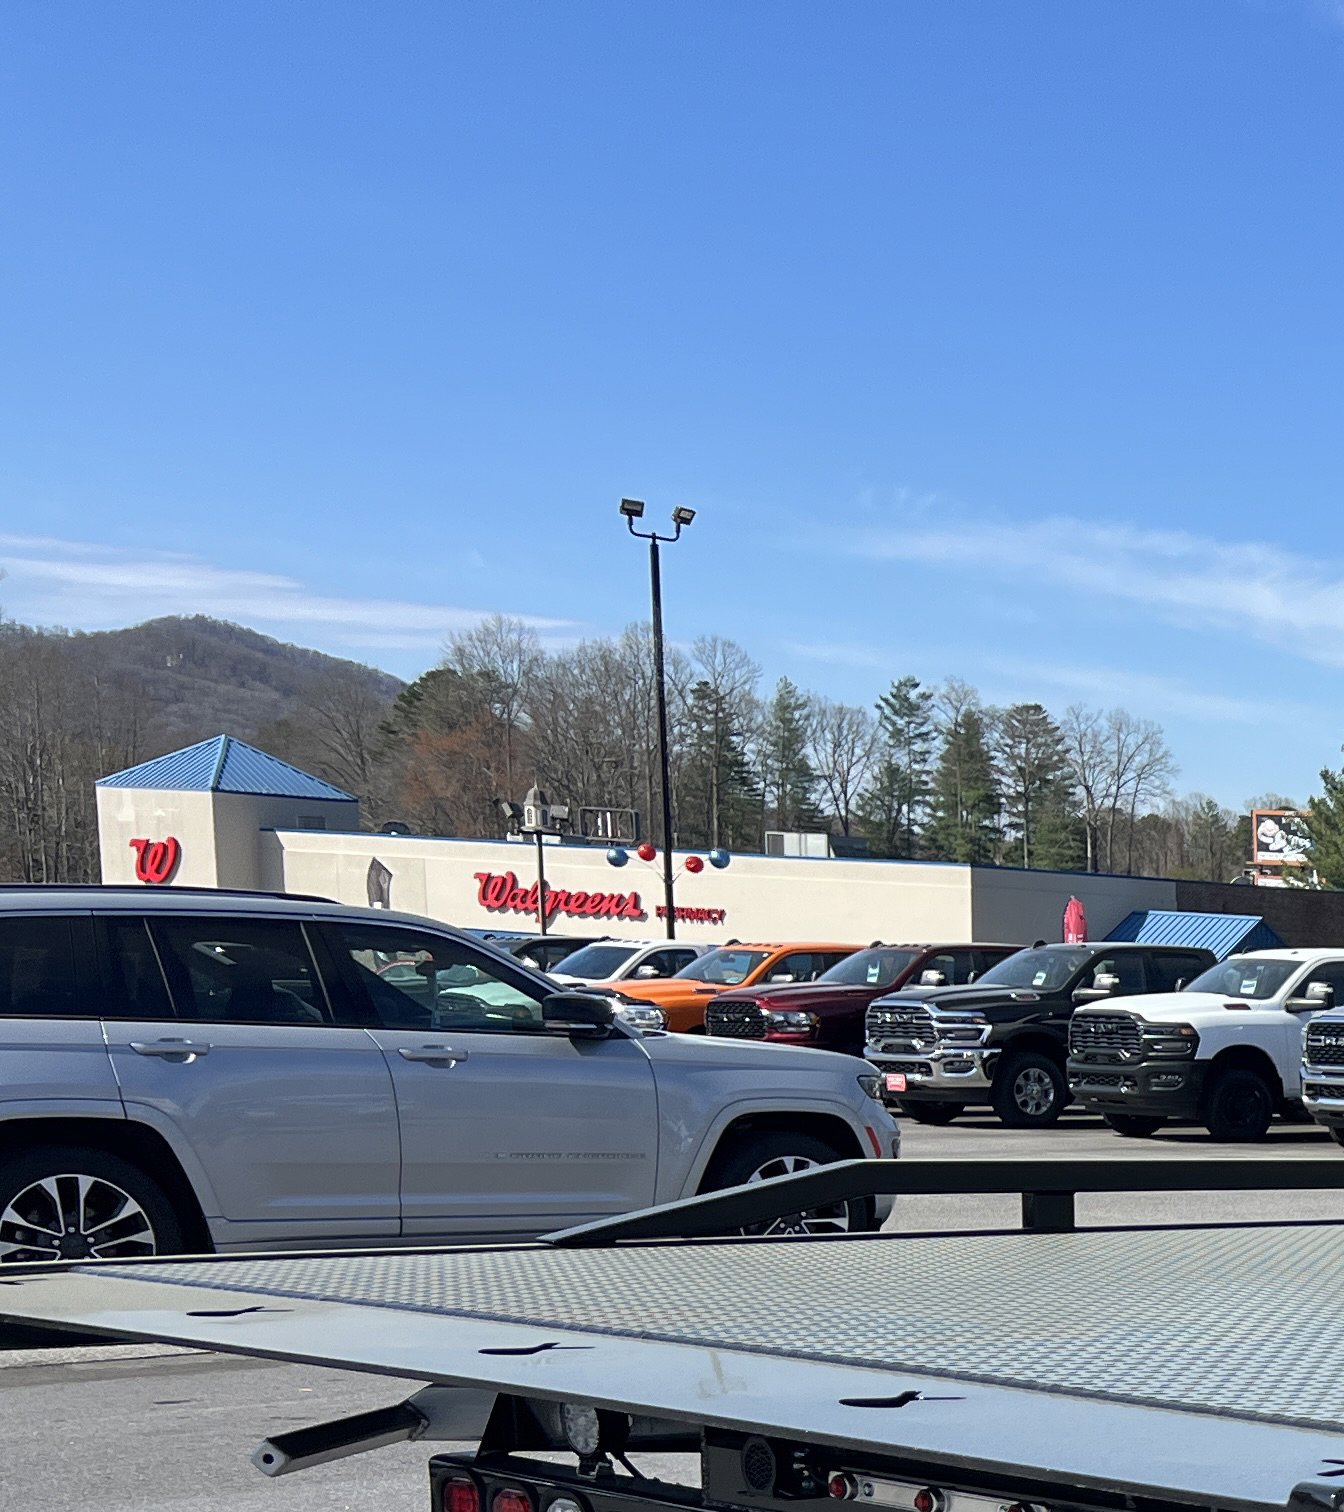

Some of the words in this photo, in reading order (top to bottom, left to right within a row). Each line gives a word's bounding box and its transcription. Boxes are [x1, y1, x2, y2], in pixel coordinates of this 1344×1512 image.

[129, 836, 177, 884] W
[474, 871, 646, 923] Walgreens
[655, 905, 727, 922] PHRMACY
